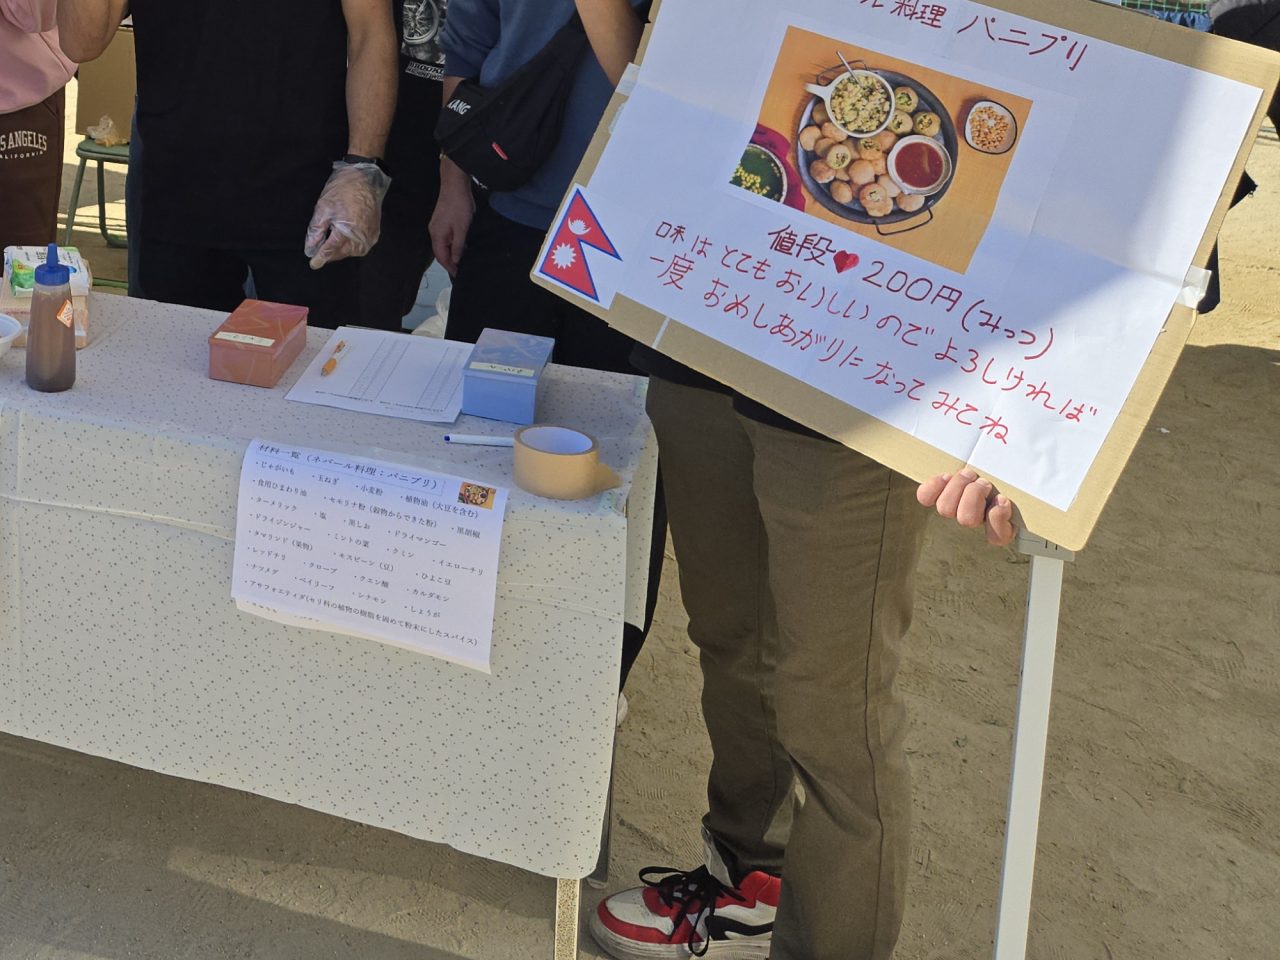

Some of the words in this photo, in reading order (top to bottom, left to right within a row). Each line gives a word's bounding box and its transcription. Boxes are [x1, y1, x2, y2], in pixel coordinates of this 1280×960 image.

[956, 15, 1088, 72] パニプリ
[7, 130, 48, 153] ANGELES
[768, 223, 836, 270] 値段
